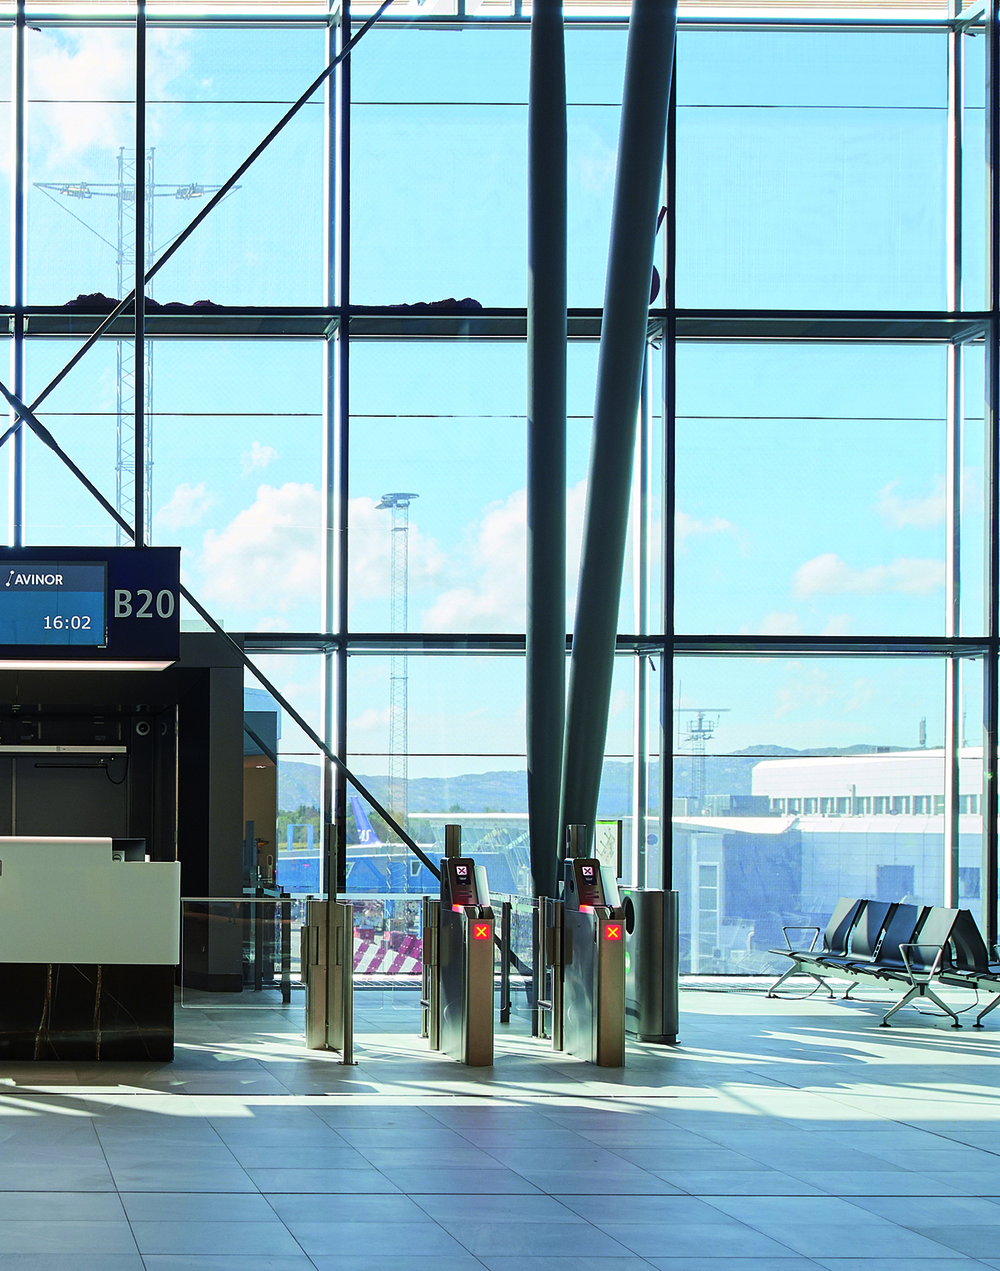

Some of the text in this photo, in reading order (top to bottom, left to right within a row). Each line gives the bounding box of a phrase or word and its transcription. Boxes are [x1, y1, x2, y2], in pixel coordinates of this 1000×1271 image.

[14, 574, 64, 586] AVINOR
[113, 589, 175, 619] B20
[43, 615, 92, 630] 16:02
